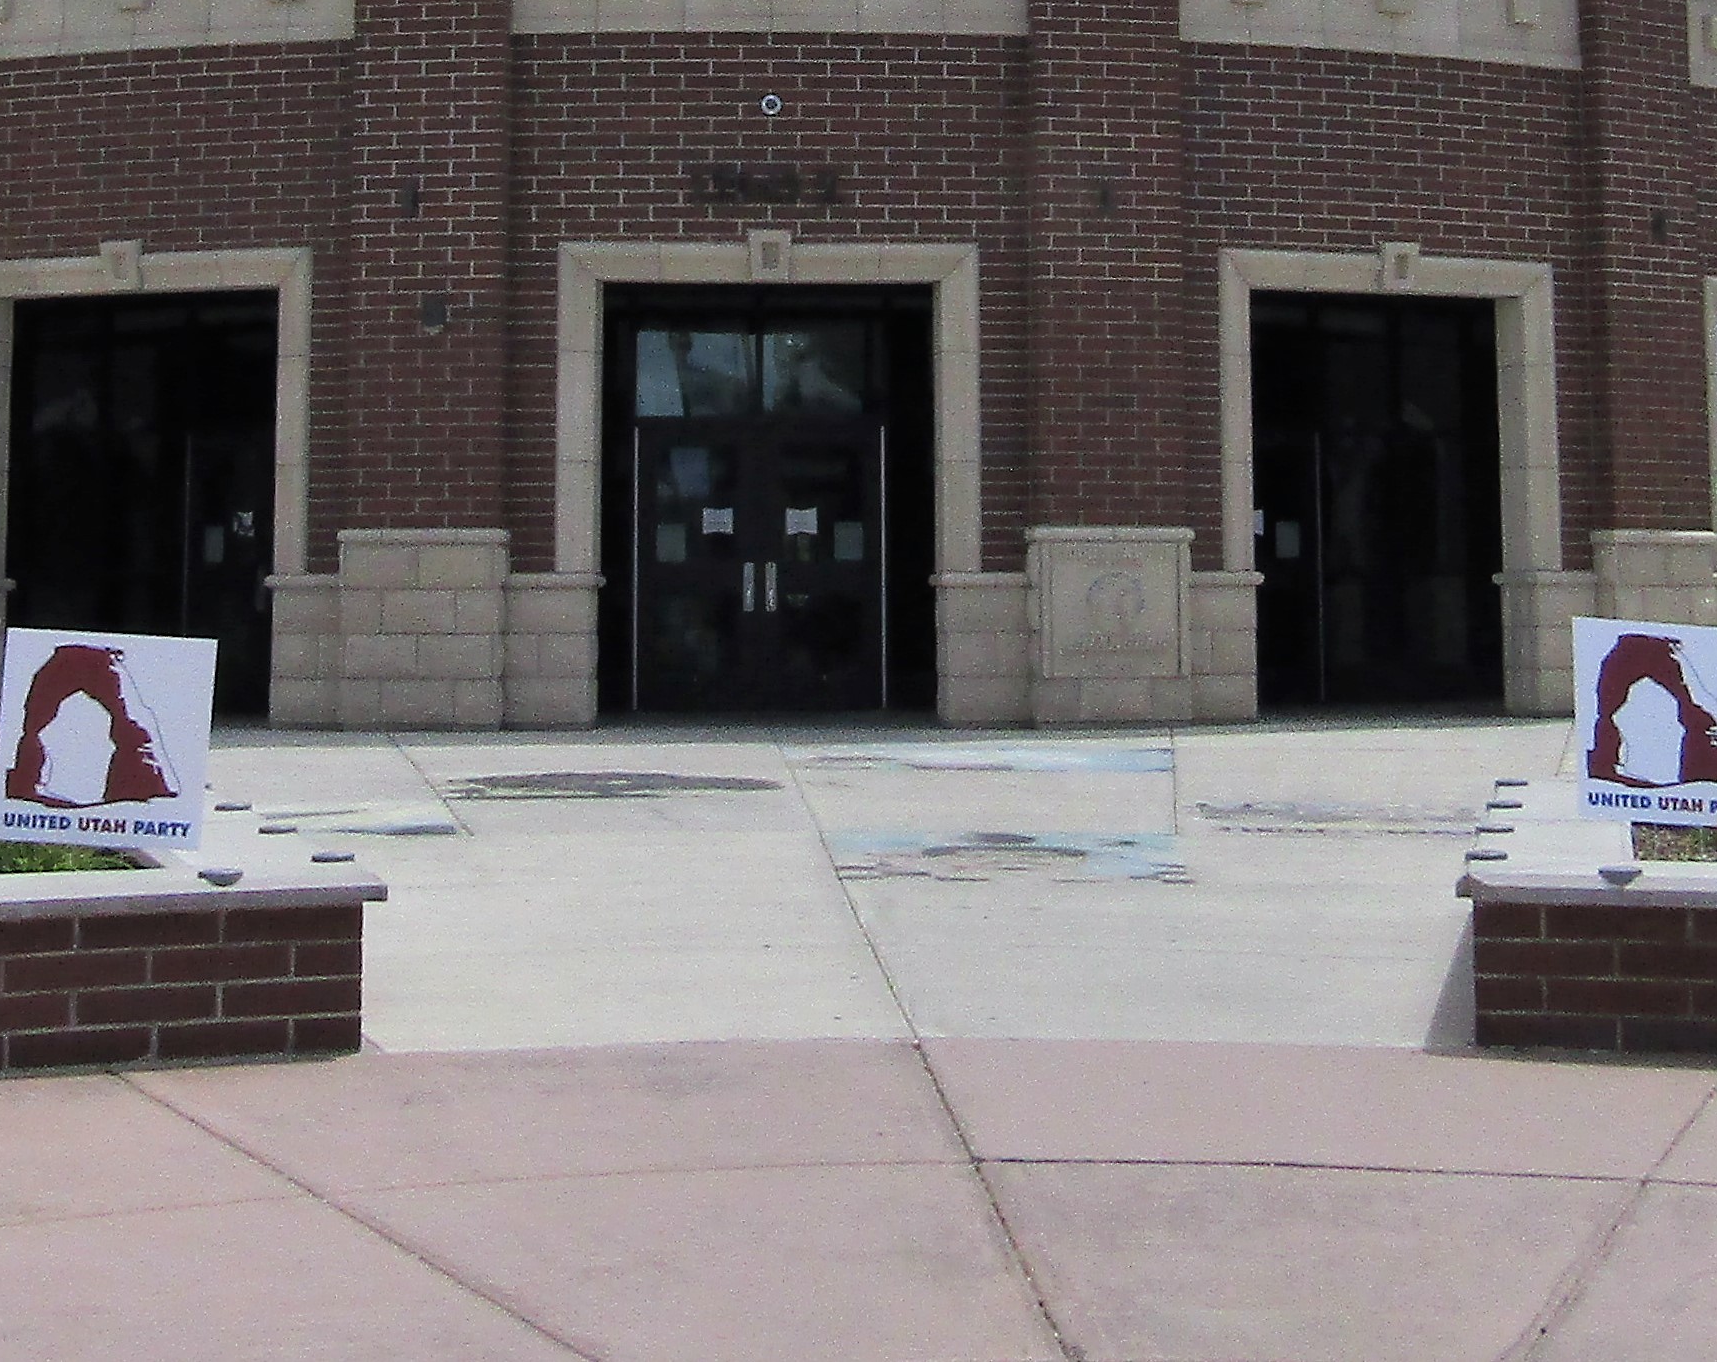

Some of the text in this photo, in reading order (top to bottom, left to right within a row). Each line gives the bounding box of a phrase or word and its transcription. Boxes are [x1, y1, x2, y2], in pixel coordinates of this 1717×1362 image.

[1587, 792, 1651, 809] UNITED
[1658, 797, 1704, 812] UTAH
[3, 812, 192, 838] UNITED UTAH PARTY
